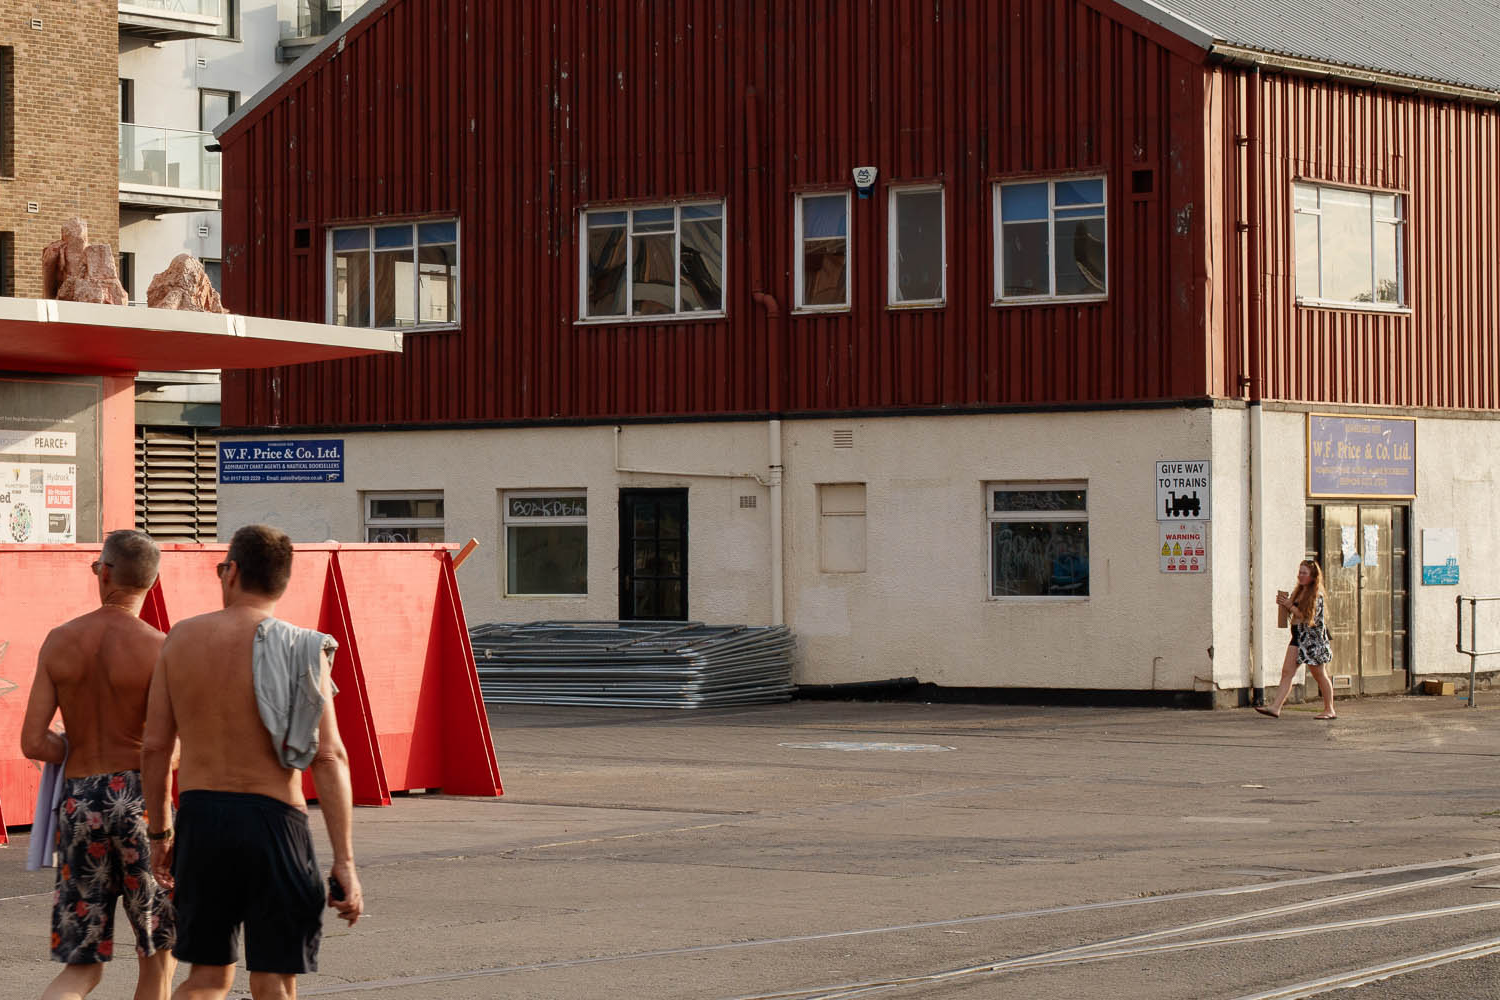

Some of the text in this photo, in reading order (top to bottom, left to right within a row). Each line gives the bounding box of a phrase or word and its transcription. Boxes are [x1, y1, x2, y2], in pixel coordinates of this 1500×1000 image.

[34, 438, 68, 448] PEARCE+
[223, 447, 340, 459] W.F. Price & Co. Ltd.
[1313, 440, 1411, 460] W.F. Price & Co. Ltd.
[1161, 464, 1204, 474] GIVE WAY
[1159, 478, 1207, 488] TO TRAINS
